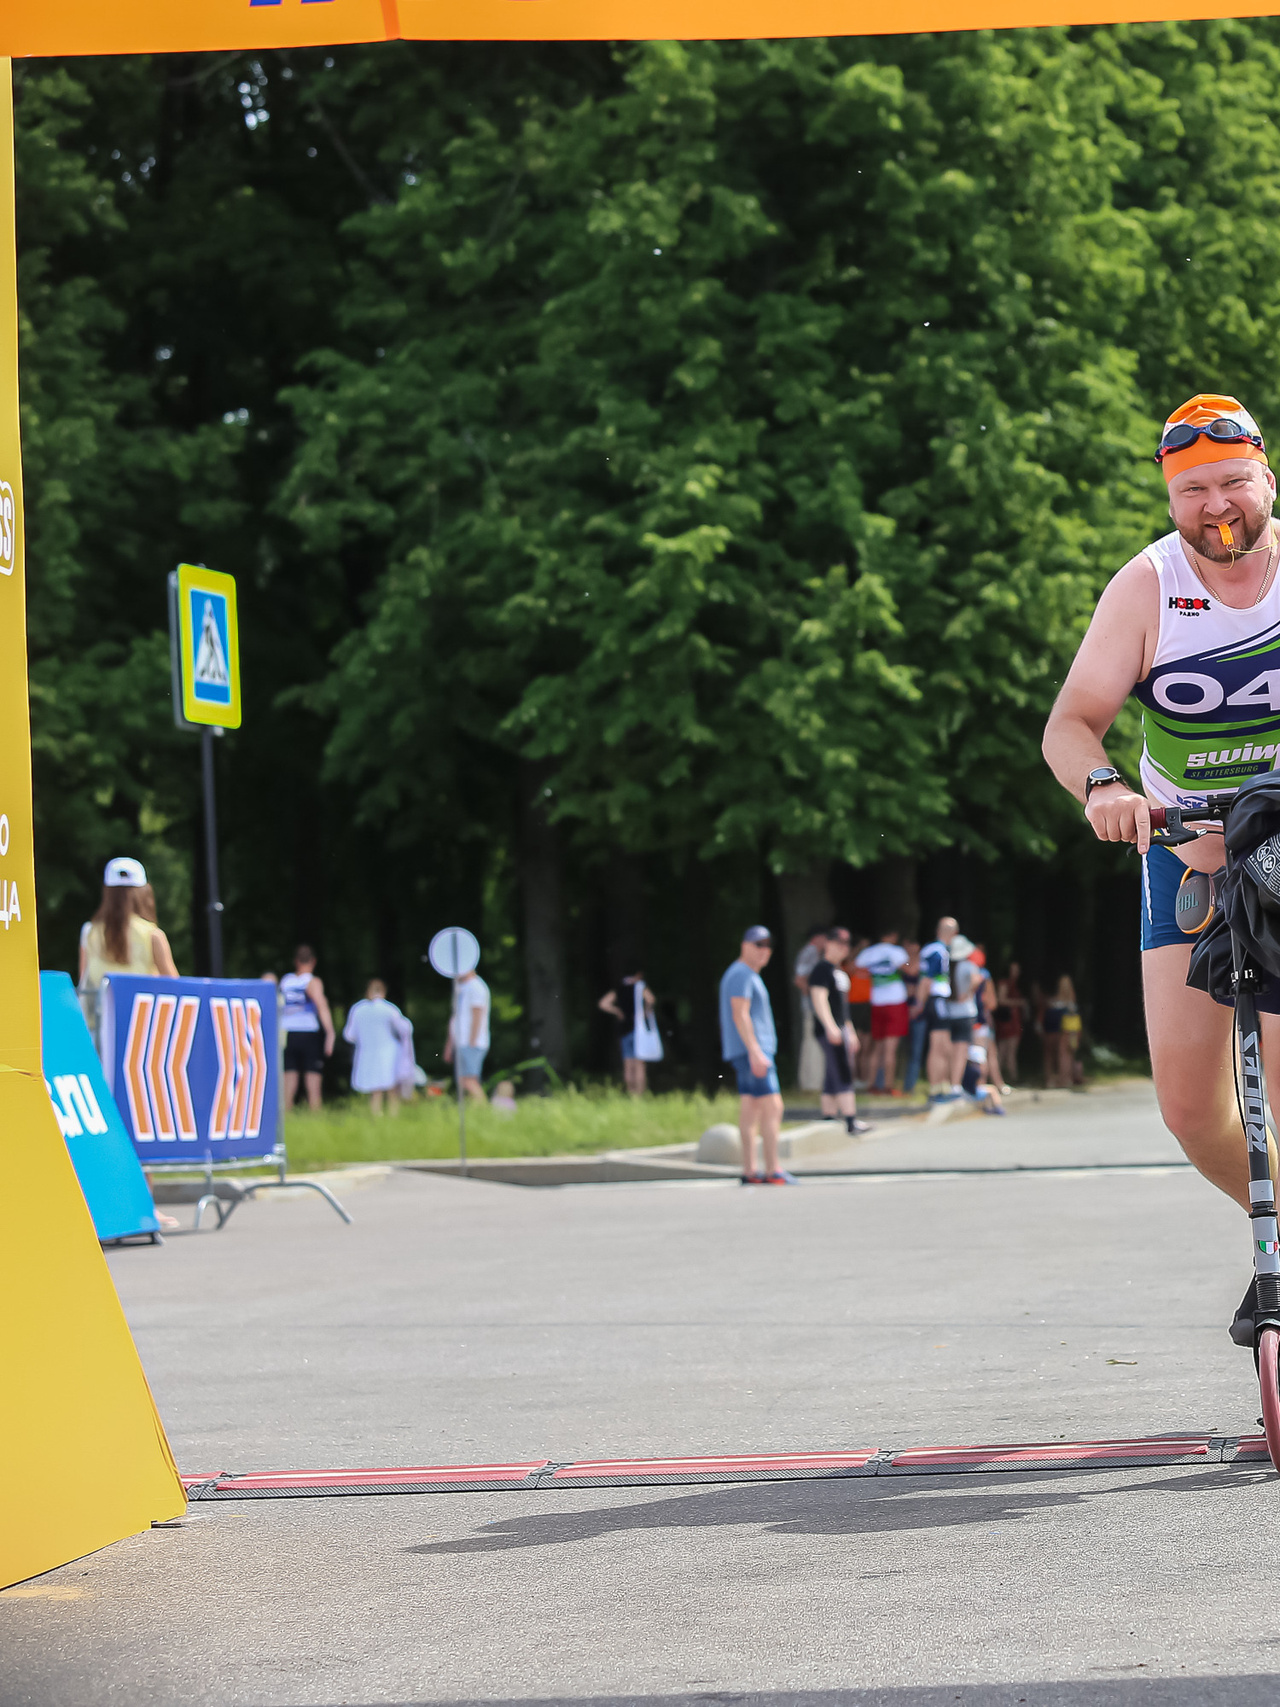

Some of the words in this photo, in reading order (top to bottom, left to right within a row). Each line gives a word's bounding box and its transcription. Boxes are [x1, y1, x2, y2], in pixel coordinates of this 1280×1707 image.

[1205, 765, 1259, 777] PETERSBURG
[1178, 892, 1200, 912] JBL
[1238, 1031, 1267, 1153] ROCES
